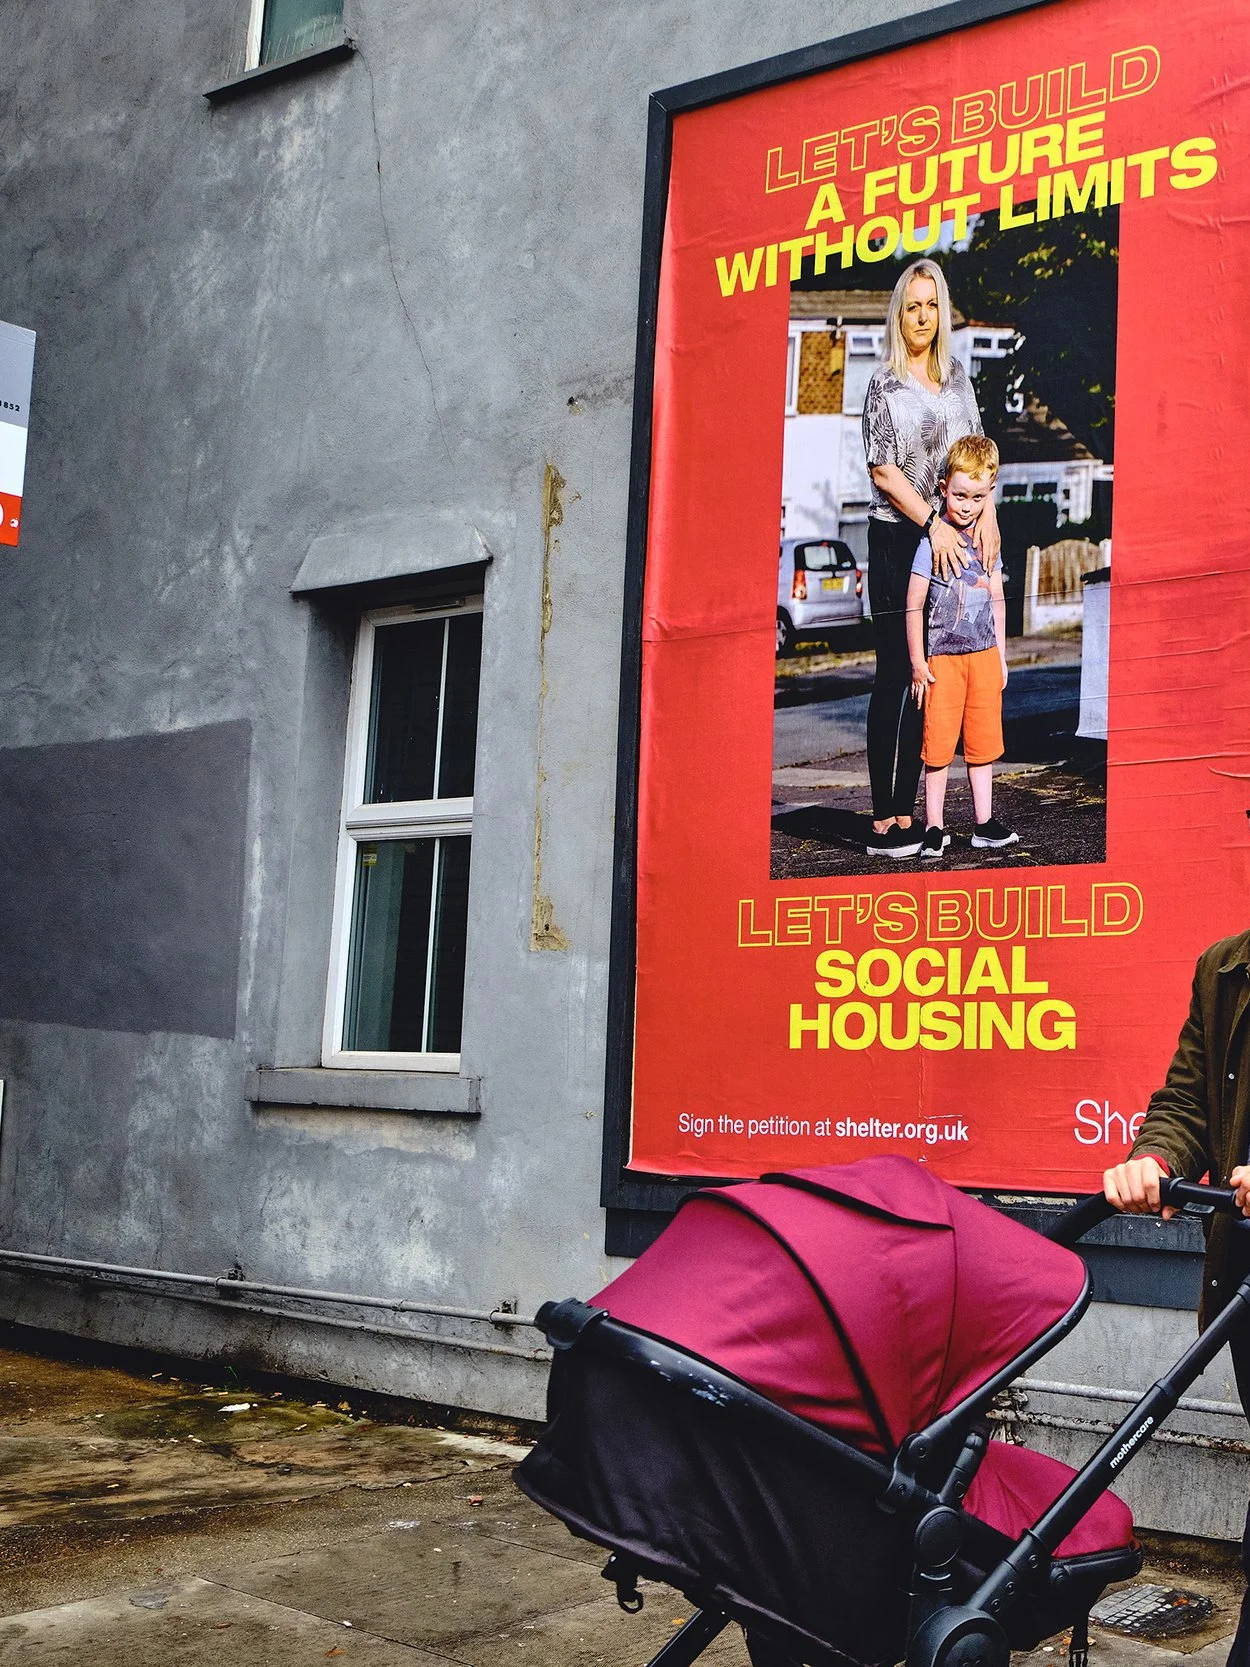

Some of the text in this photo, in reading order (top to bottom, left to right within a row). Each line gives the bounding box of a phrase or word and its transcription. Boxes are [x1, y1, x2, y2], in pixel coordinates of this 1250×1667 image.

[765, 45, 1161, 193] LET’S BUILD
[805, 111, 1106, 231] A FUTURE
[715, 137, 1219, 297] WITHOUT LIMITS
[738, 882, 1144, 948] LET’S BUILD
[814, 946, 1048, 998] SOCIAL
[788, 999, 1077, 1052] HOUSING
[679, 1113, 969, 1145] Sign the petition at shelter.org.uk
[1074, 1099, 1147, 1145] She
[1110, 1416, 1154, 1469] mothercare
